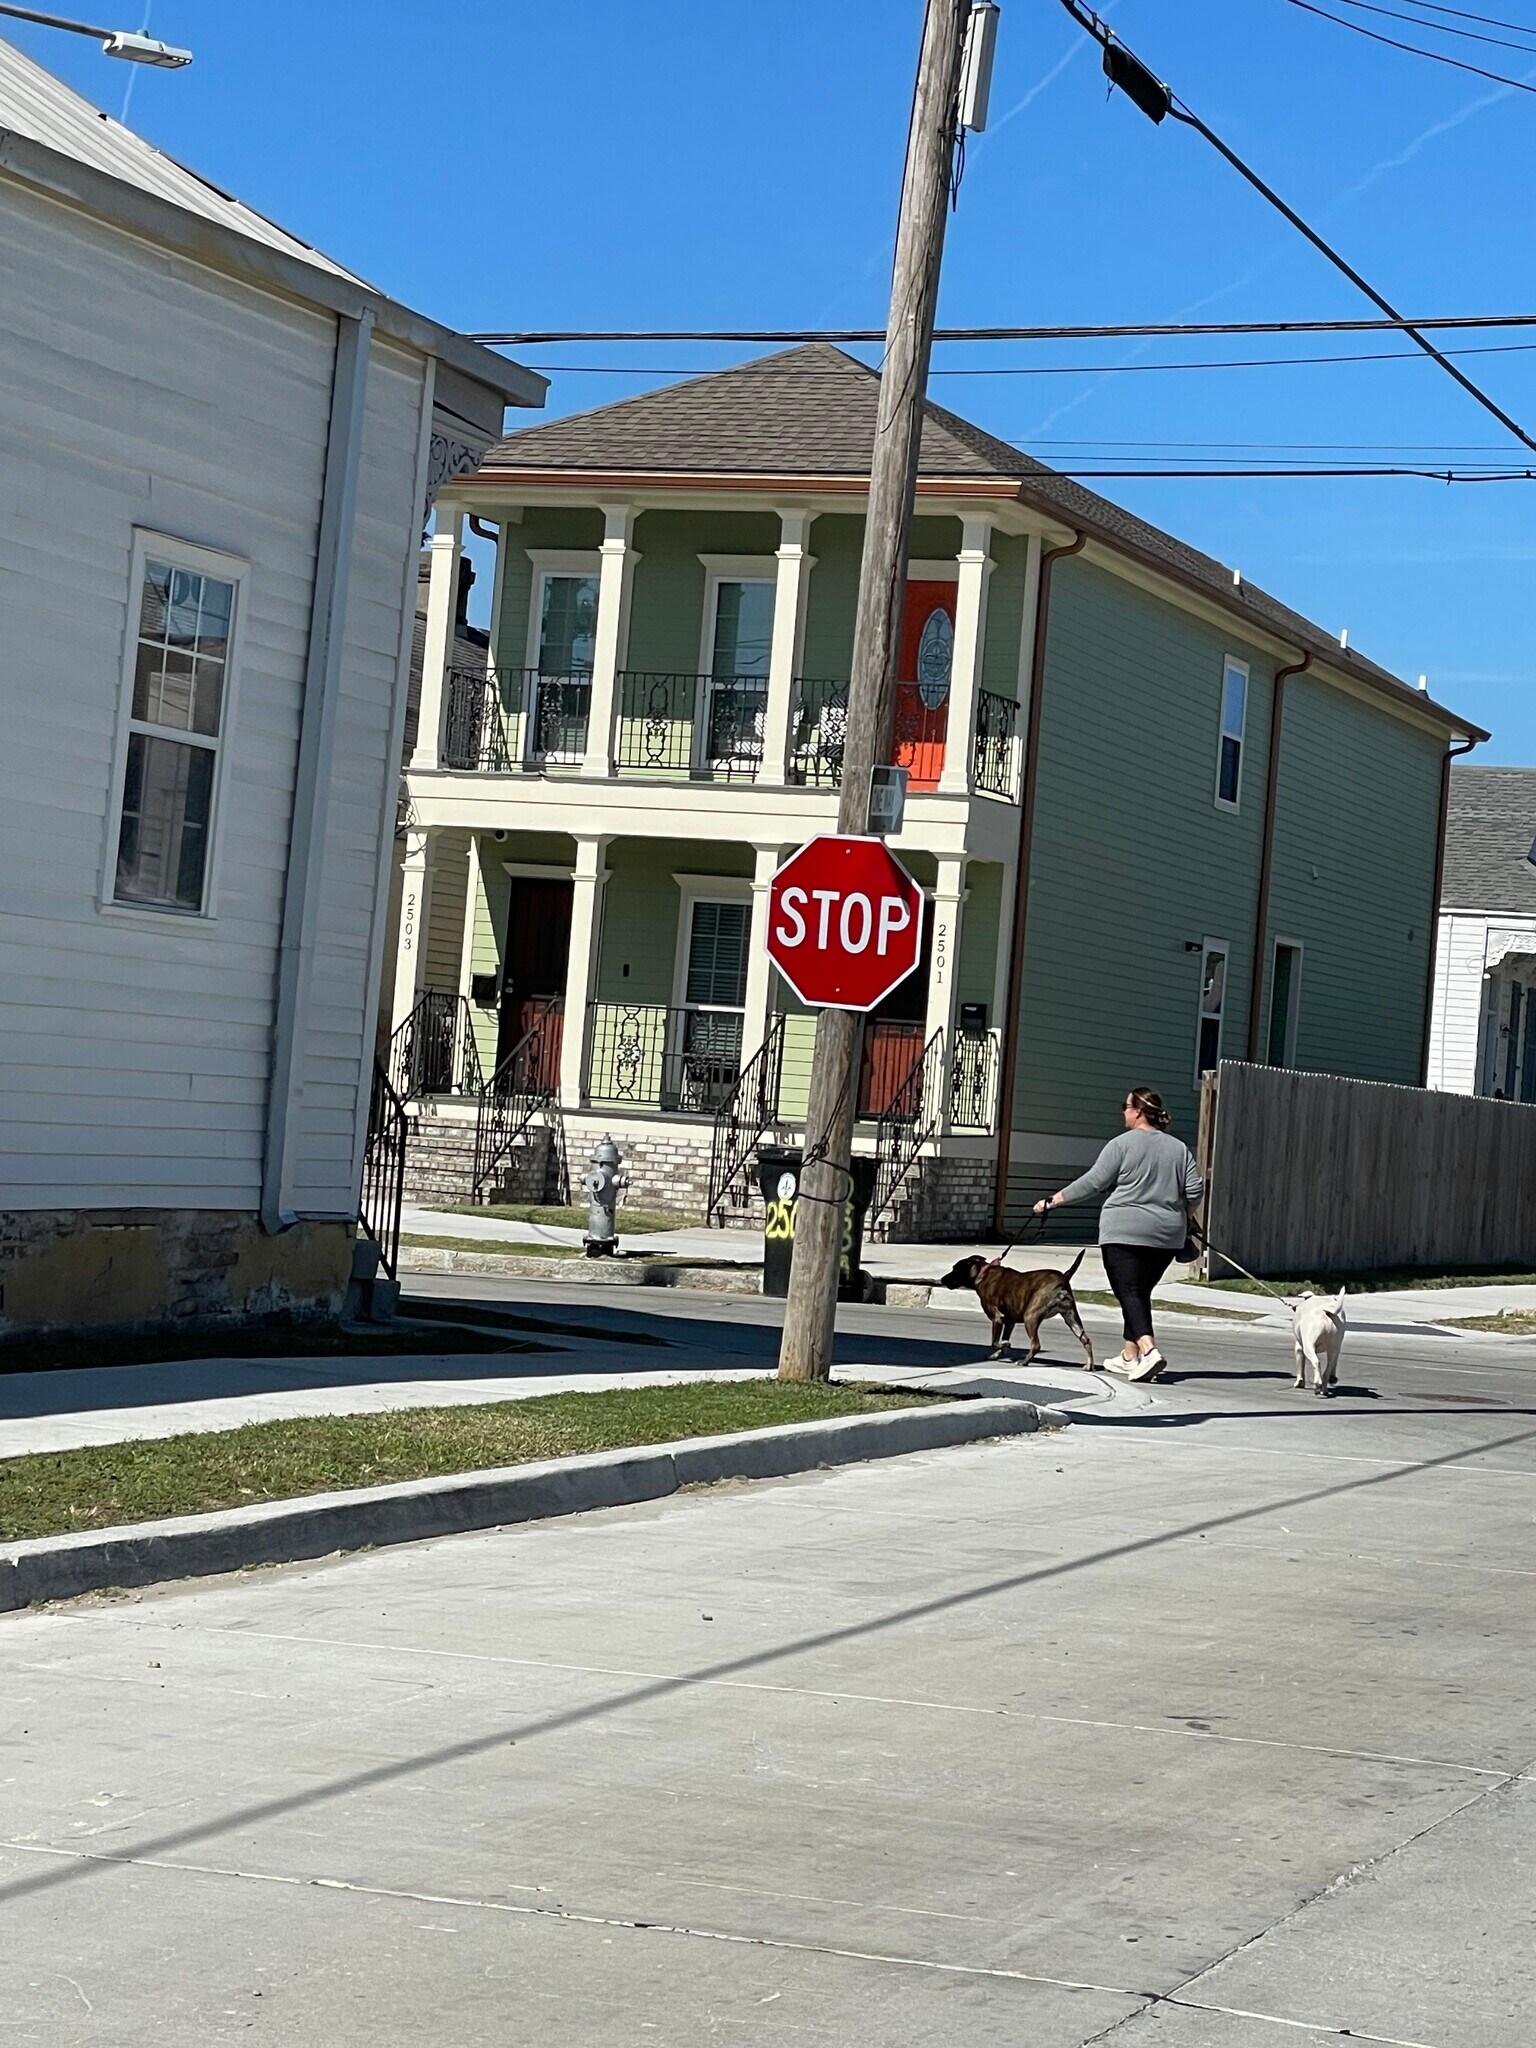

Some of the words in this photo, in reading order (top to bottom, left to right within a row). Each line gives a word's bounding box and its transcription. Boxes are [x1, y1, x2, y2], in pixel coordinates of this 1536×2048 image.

[404, 894, 415, 950] 2503
[776, 886, 910, 956] STOP
[936, 924, 947, 983] 2501
